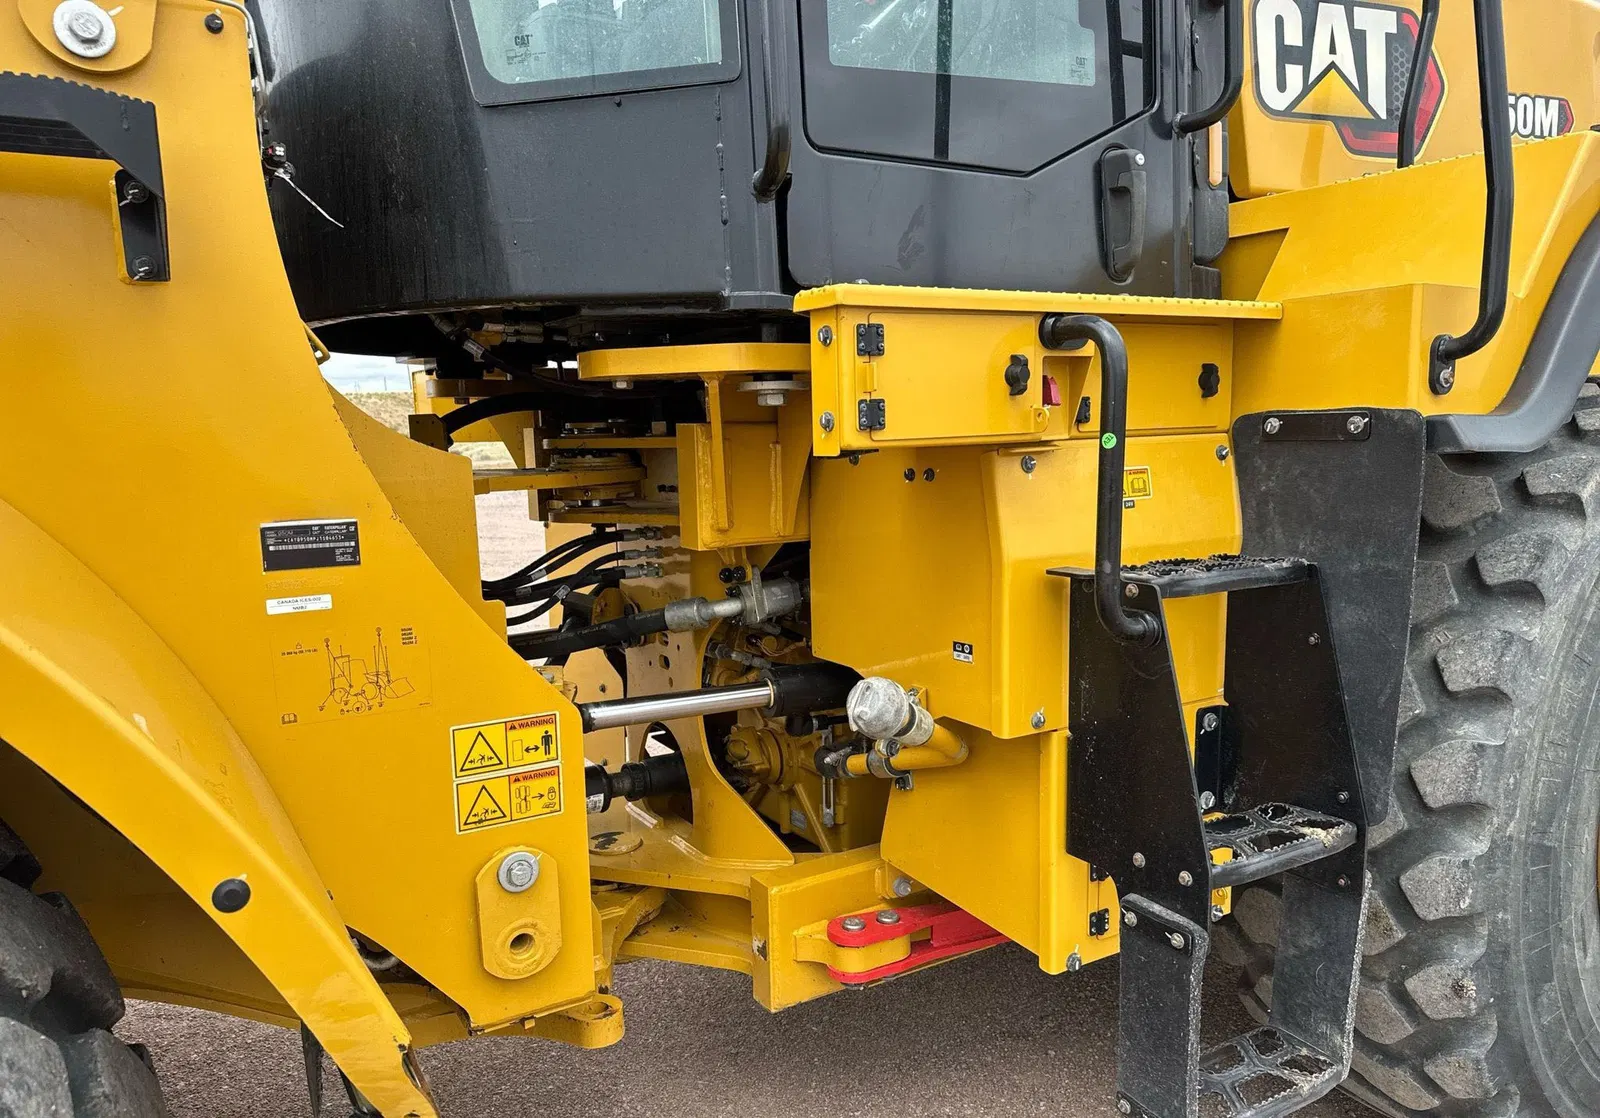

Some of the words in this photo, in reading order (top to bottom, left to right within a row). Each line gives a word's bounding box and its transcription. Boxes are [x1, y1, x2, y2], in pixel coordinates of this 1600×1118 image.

[514, 34, 530, 46] CAT
[1255, 0, 1397, 120] CAT
[518, 717, 554, 729] WARNING
[522, 769, 556, 781] WARNING
